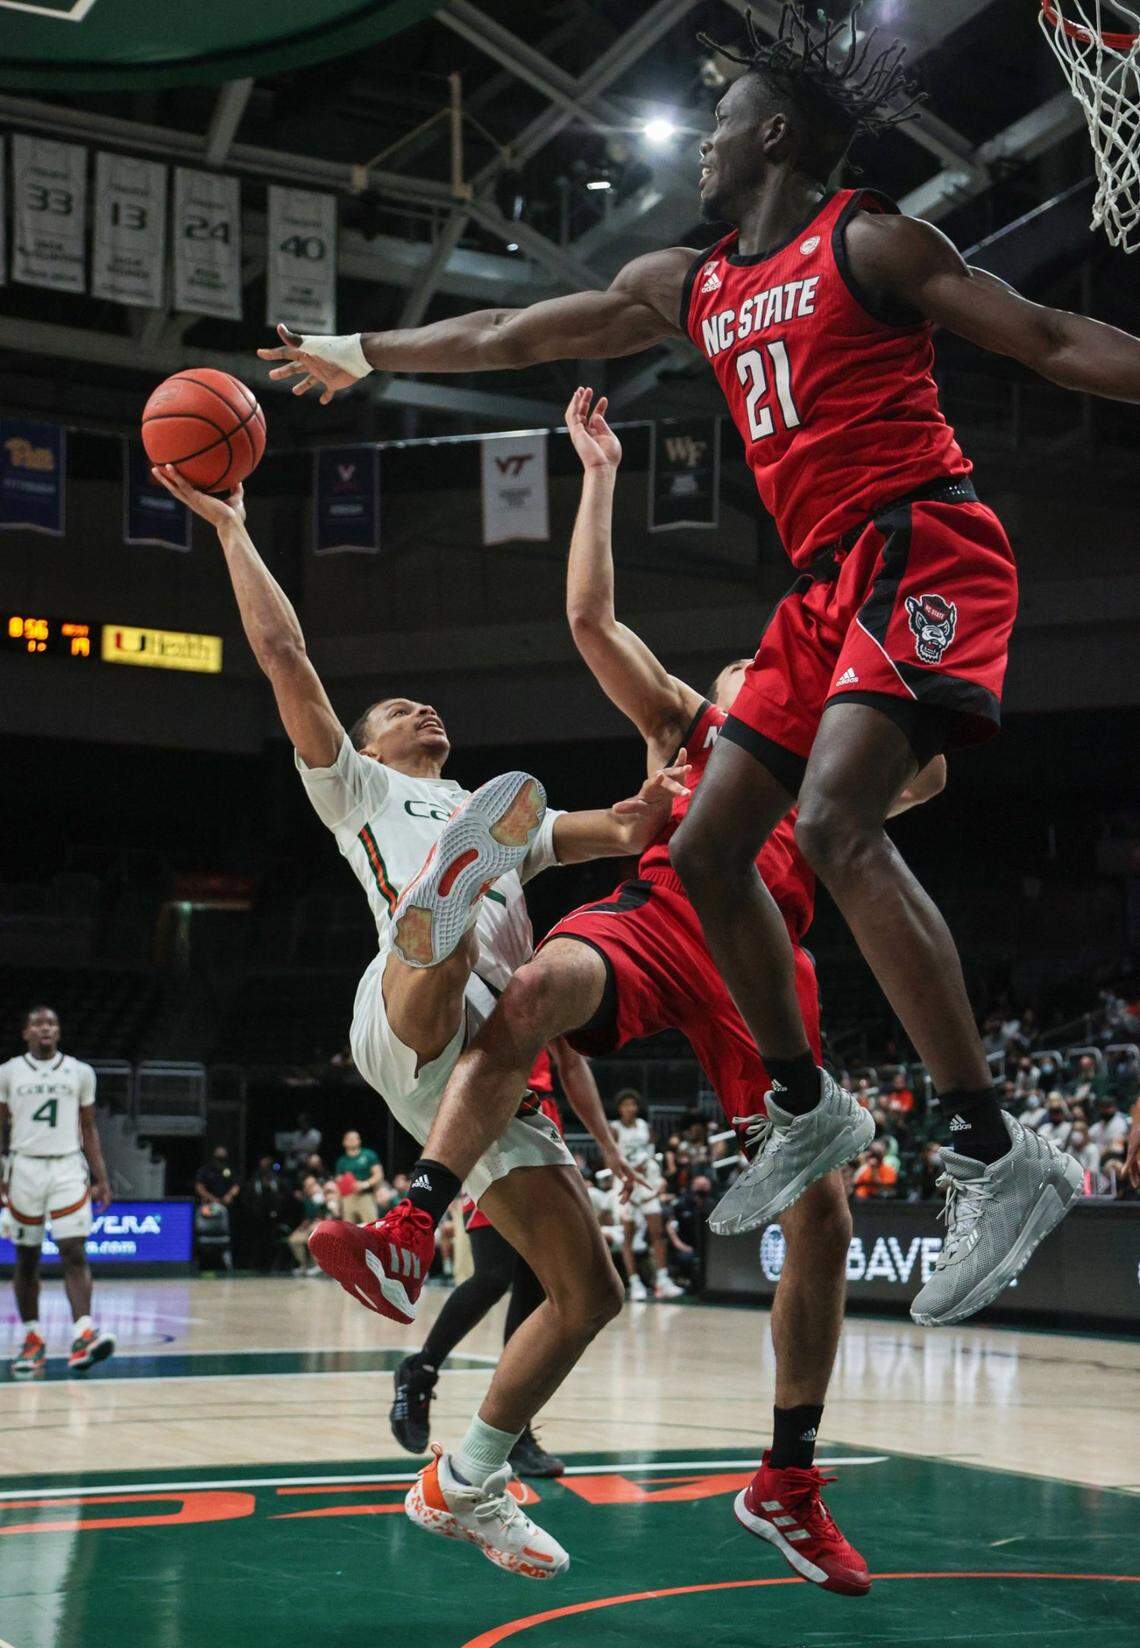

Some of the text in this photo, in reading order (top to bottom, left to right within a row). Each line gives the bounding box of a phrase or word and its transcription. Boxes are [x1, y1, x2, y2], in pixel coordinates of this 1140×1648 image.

[26, 182, 73, 217] 33
[110, 201, 148, 231] 13
[184, 214, 230, 245] 24
[280, 234, 326, 262] 40
[701, 275, 821, 358] NC STATE
[736, 340, 800, 443] 21
[495, 453, 533, 477] VT
[702, 726, 718, 749] N
[31, 1098, 58, 1128] 4
[949, 1123, 972, 1132] adidas
[845, 1237, 942, 1283] BAVE
